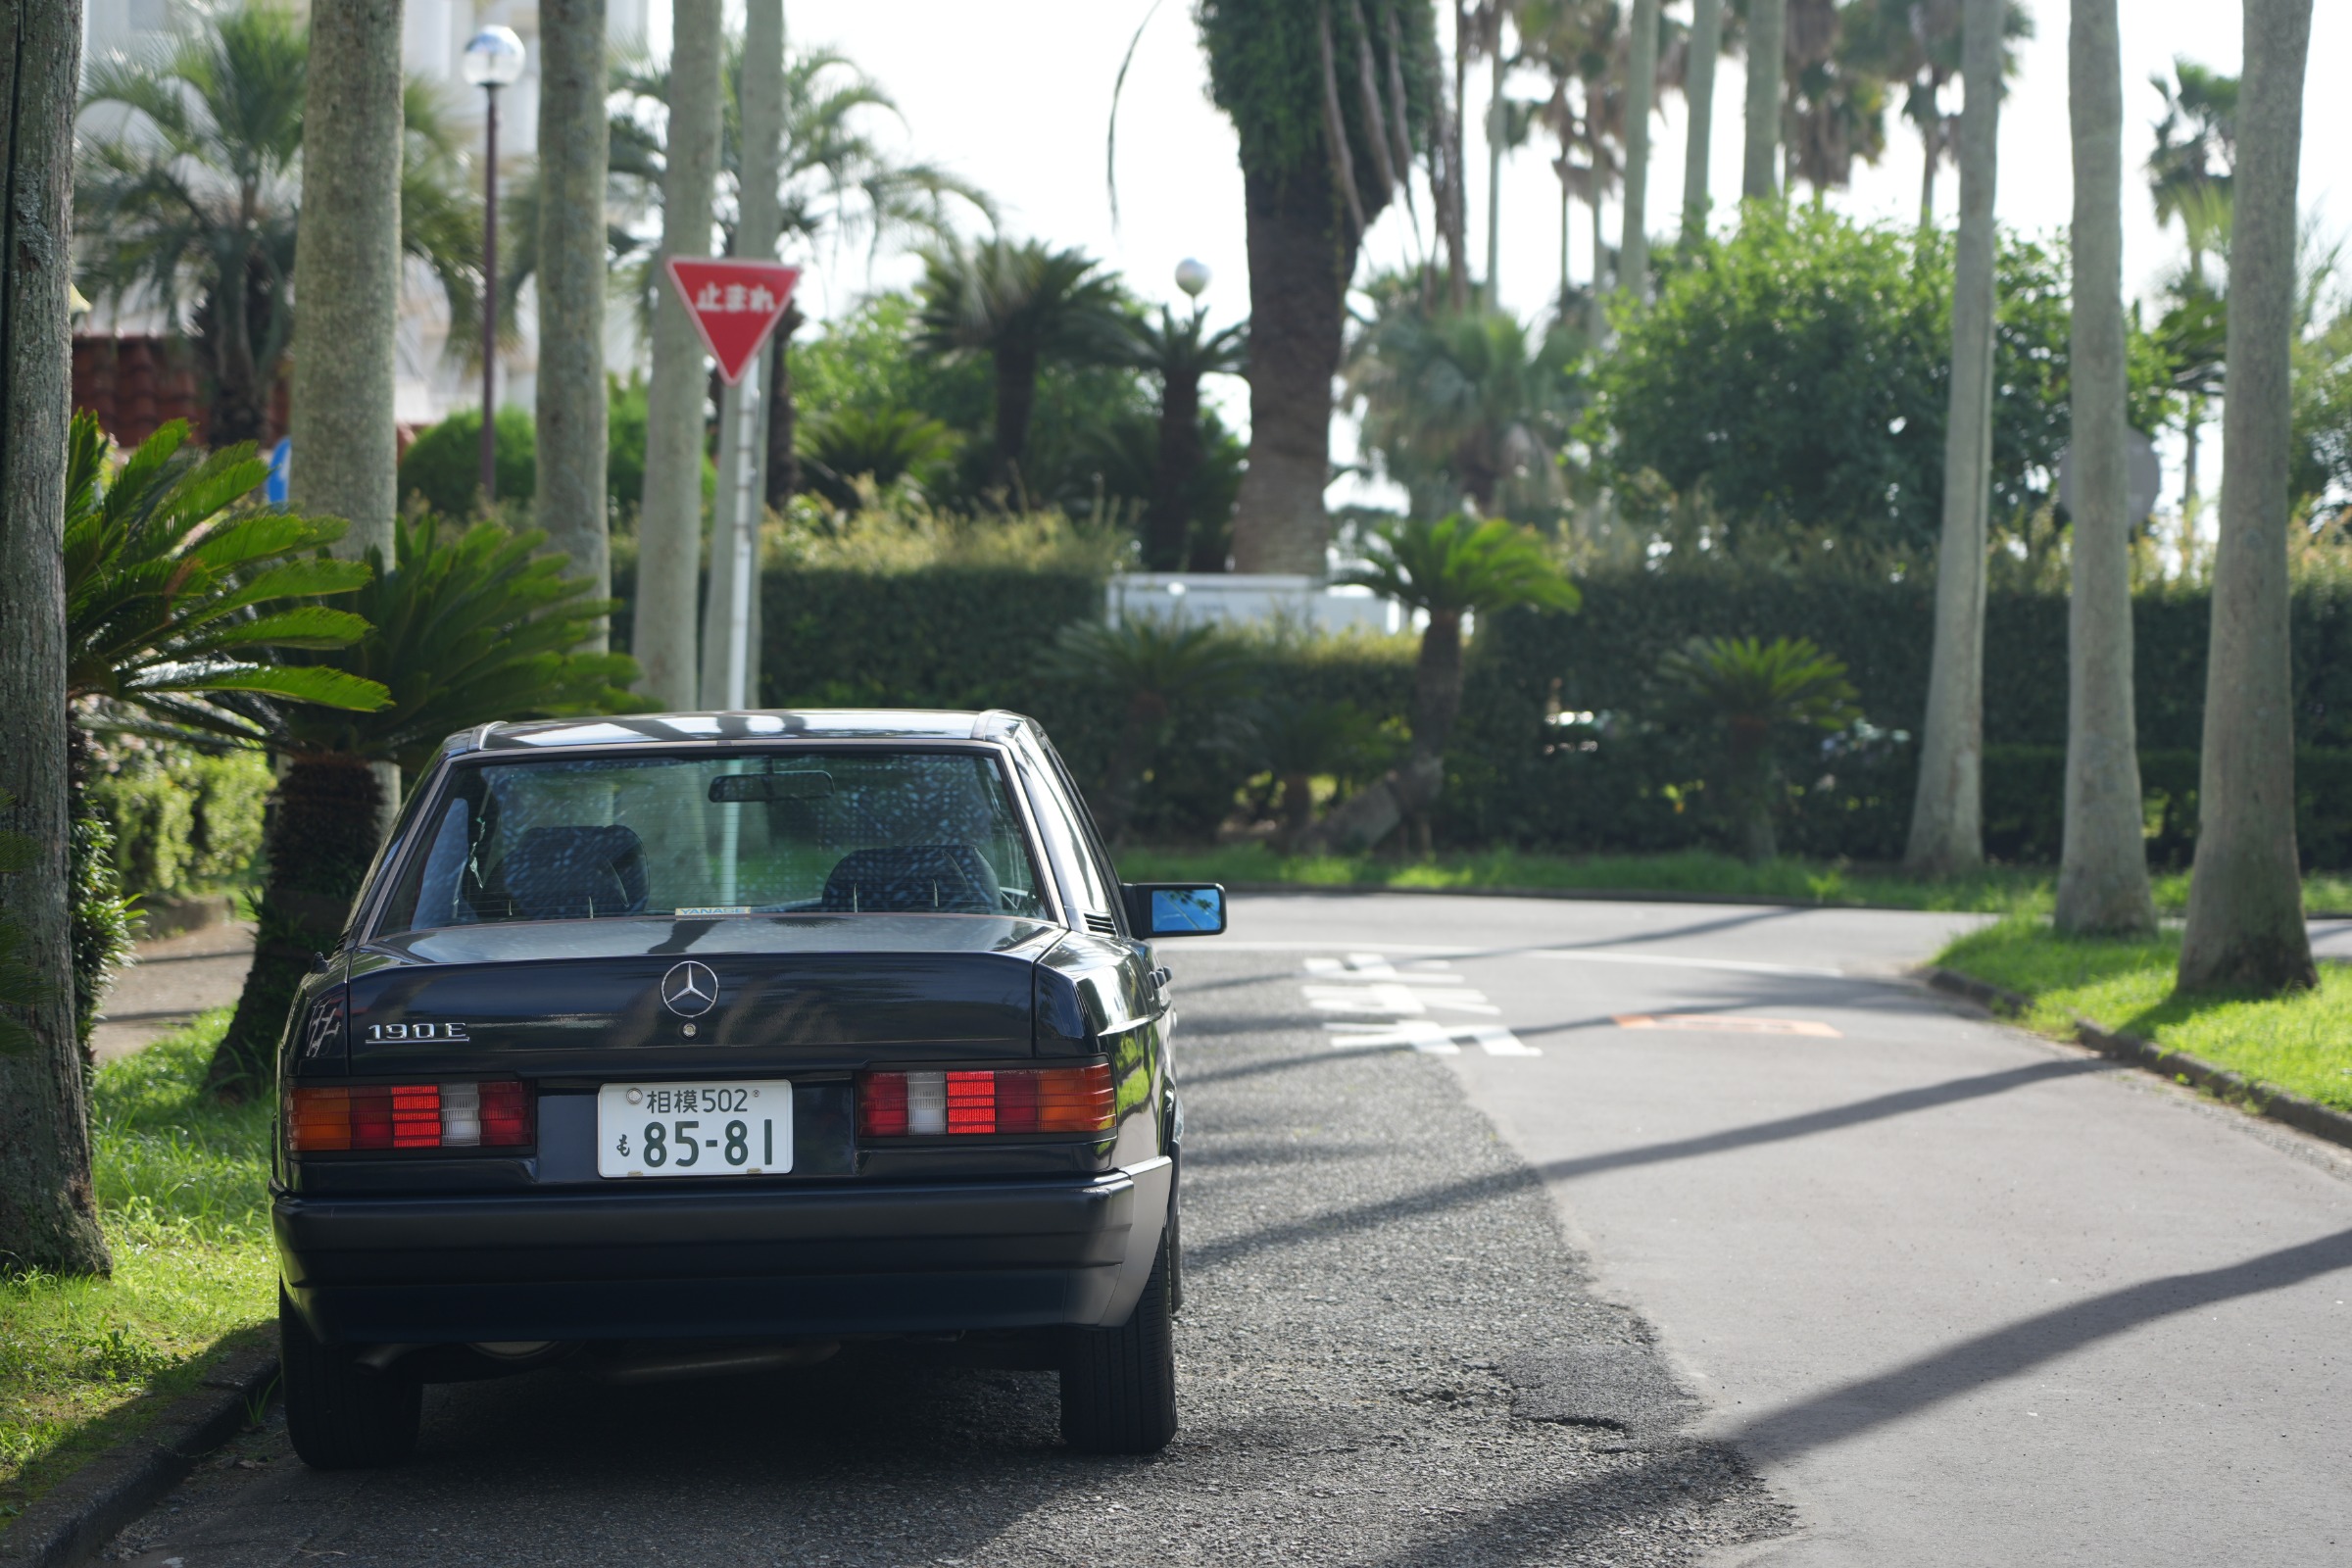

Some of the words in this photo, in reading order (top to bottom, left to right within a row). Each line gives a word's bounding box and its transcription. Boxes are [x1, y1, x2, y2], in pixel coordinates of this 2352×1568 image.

[697, 281, 775, 314] 止まれ
[368, 1023, 435, 1040] 190
[445, 1022, 466, 1038] E
[643, 1119, 773, 1168] 85-81
